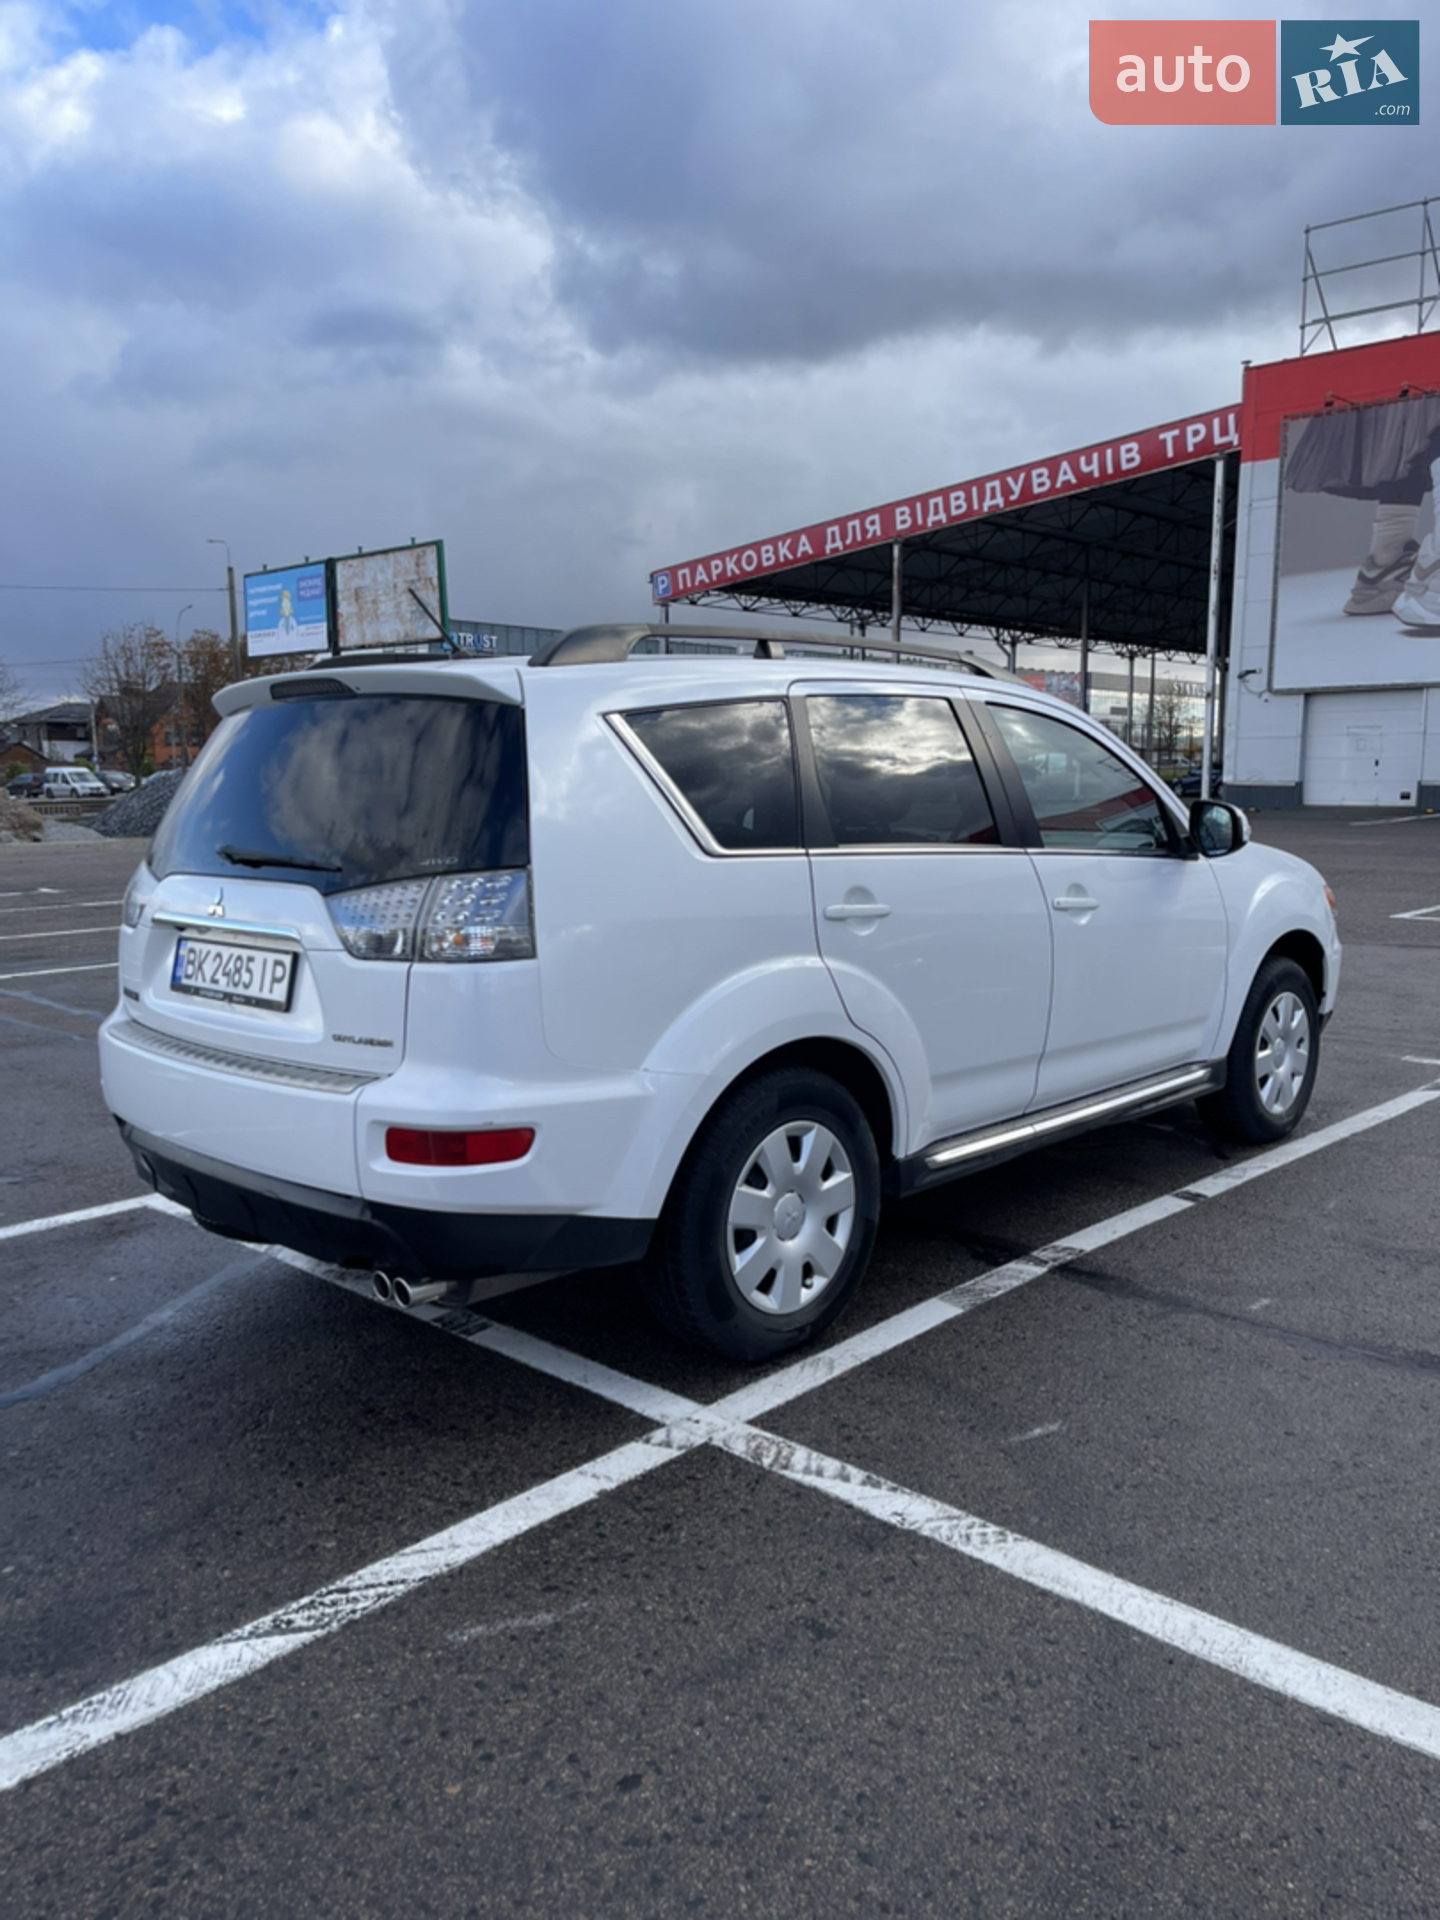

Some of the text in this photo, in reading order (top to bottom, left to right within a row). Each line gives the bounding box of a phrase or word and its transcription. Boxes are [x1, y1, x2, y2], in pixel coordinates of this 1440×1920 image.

[677, 534, 814, 590] ПАРКОВКА
[825, 513, 882, 555] ДЛЯ
[895, 441, 1142, 531] ВІДВІДУВАЧІВ
[1159, 413, 1239, 459] ТРЦ
[458, 632, 498, 651] TRUST
